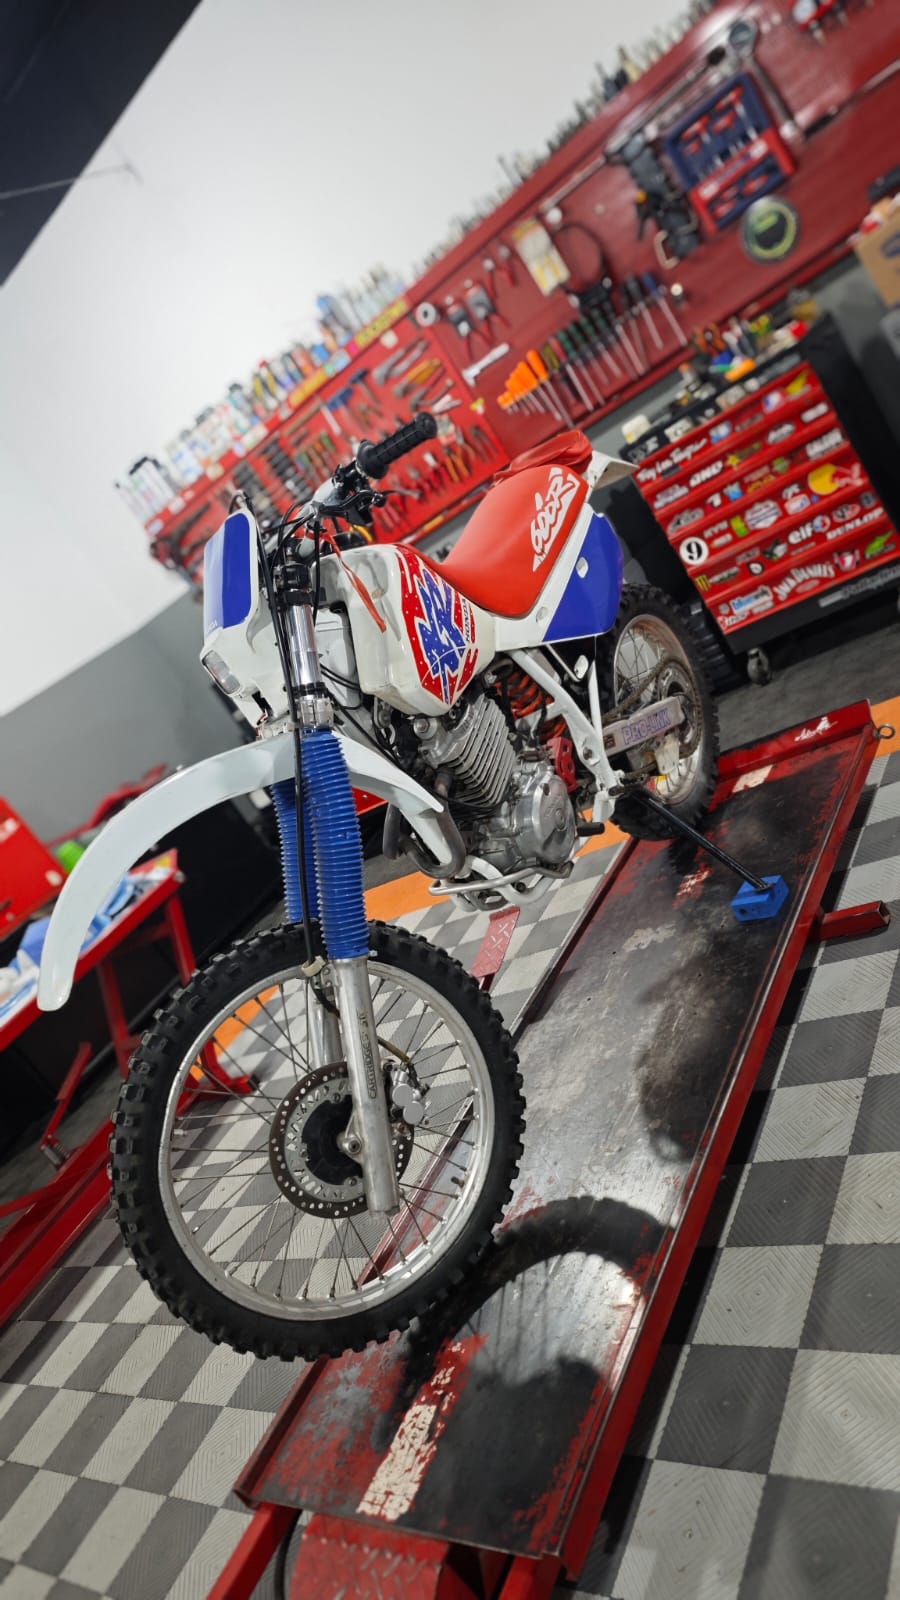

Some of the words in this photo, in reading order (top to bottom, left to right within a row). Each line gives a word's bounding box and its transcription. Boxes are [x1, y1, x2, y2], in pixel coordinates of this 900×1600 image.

[788, 522, 814, 545] elf
[826, 507, 884, 540] DUNLOP
[461, 598, 472, 643] HONDA
